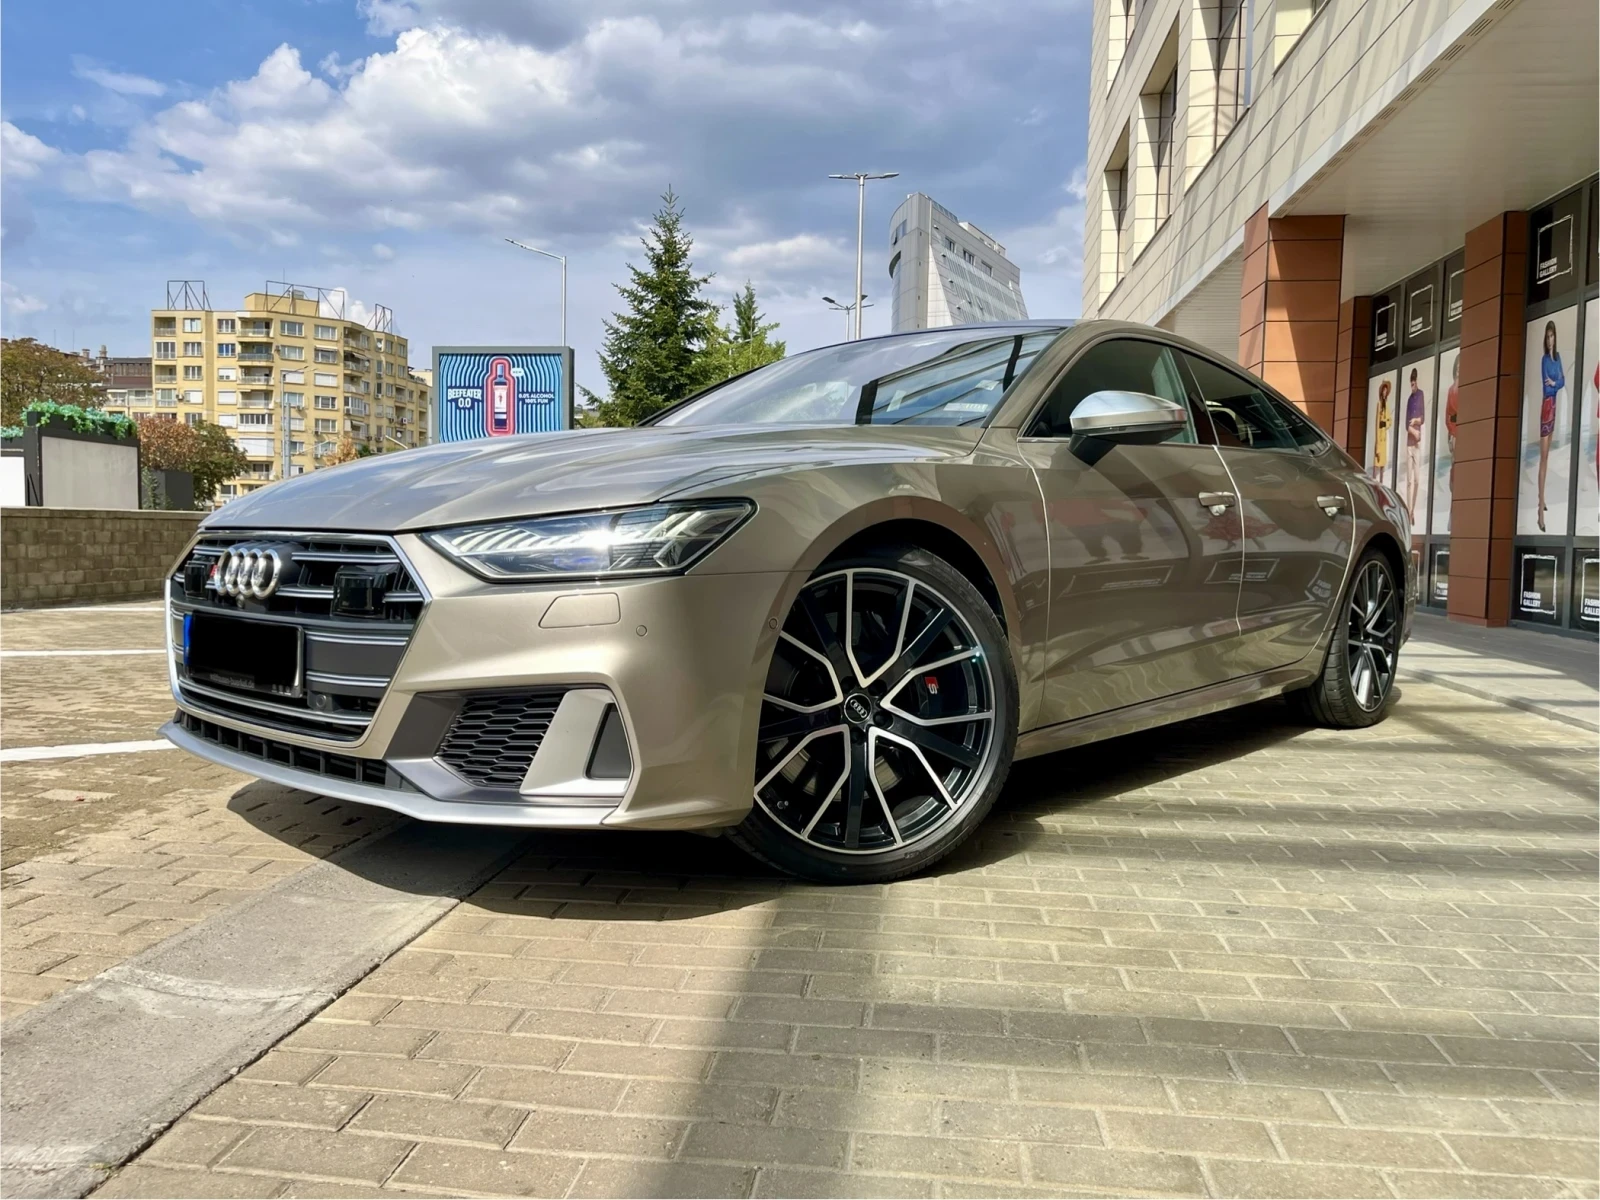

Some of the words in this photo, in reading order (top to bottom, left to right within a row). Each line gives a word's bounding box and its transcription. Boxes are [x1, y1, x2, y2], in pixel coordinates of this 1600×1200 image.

[1540, 257, 1557, 270] FASHION
[1540, 265, 1557, 278] GALLERY
[448, 388, 482, 400] BEEFEATER
[458, 397, 472, 408] 0.0
[1523, 590, 1541, 600] FASHION
[1523, 598, 1541, 607] GALLERY
[1584, 606, 1599, 616] GALLE
